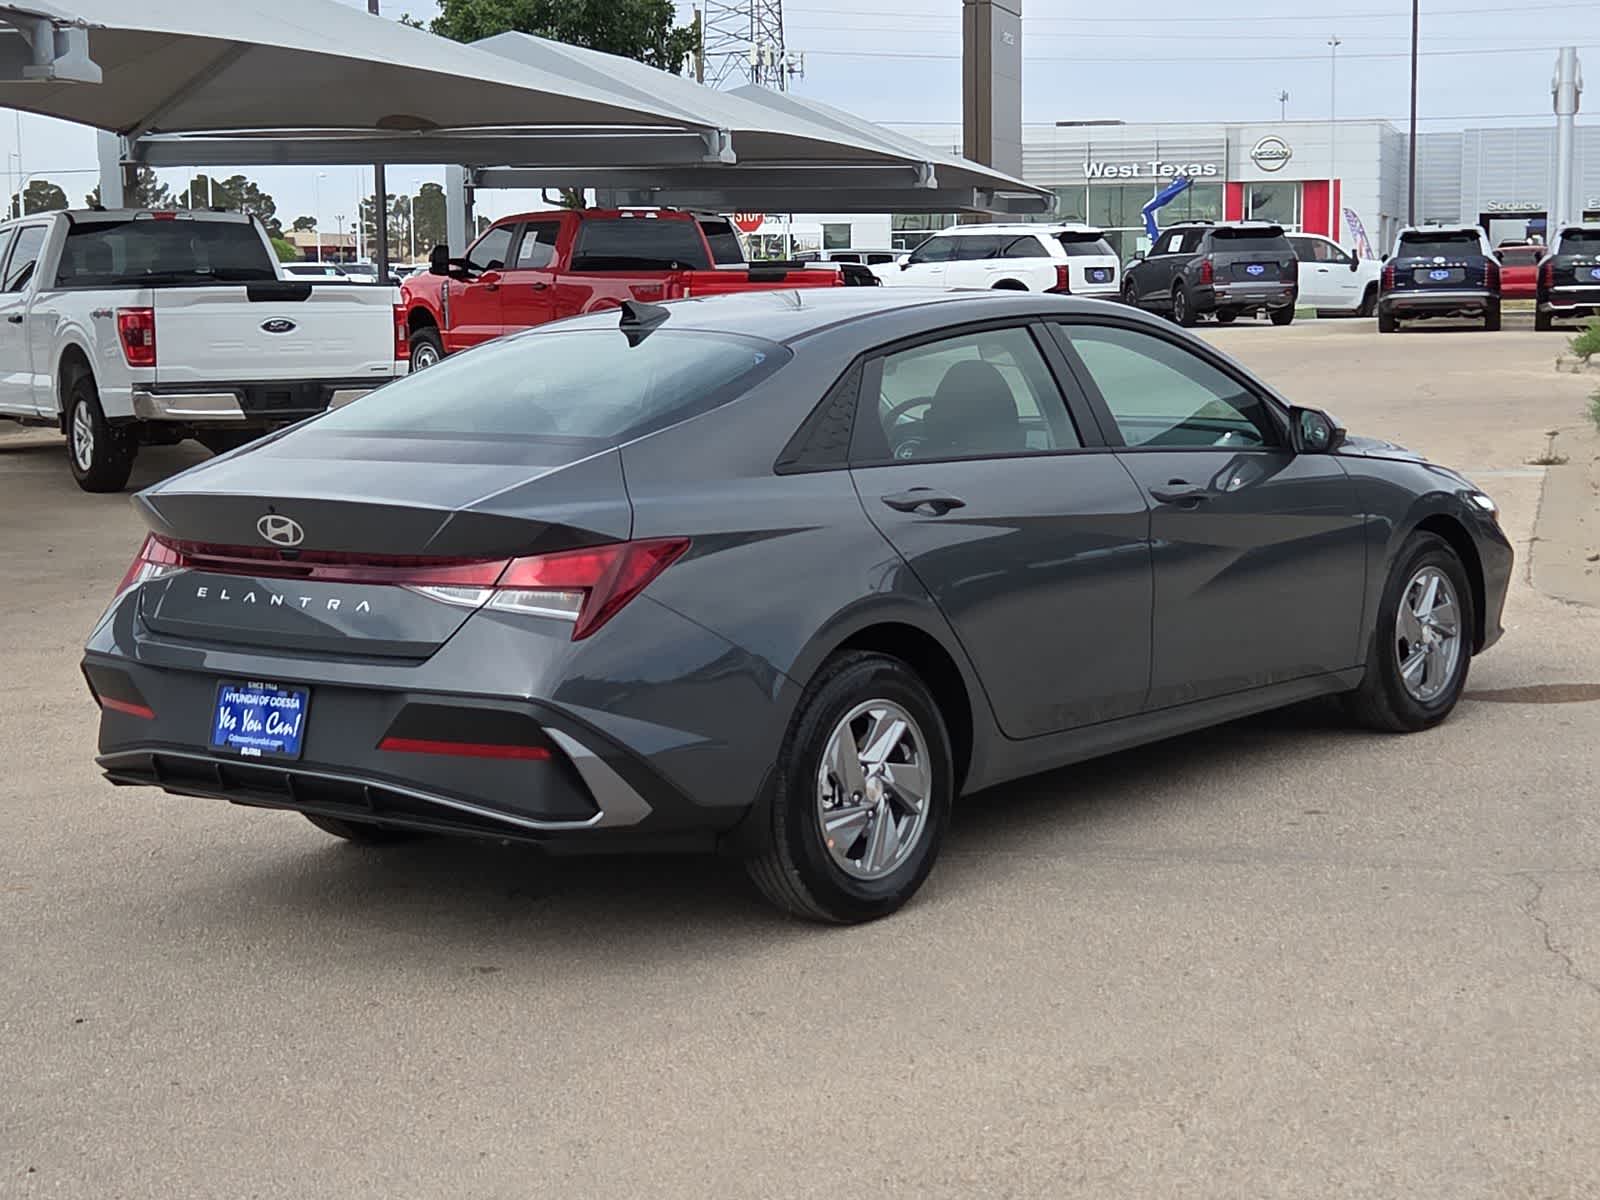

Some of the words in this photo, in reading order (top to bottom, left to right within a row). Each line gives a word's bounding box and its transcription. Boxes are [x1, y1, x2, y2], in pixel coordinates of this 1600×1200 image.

[1083, 161, 1140, 179] West
[1148, 160, 1217, 178] Texas
[735, 212, 760, 222] STOP
[196, 586, 371, 613] ELANTRA
[225, 692, 259, 705] HYUNDAI
[258, 695, 270, 706] OF
[269, 697, 300, 709] ODESSA
[218, 706, 237, 731] Yes
[241, 709, 262, 732] You
[265, 711, 302, 738] Can!
